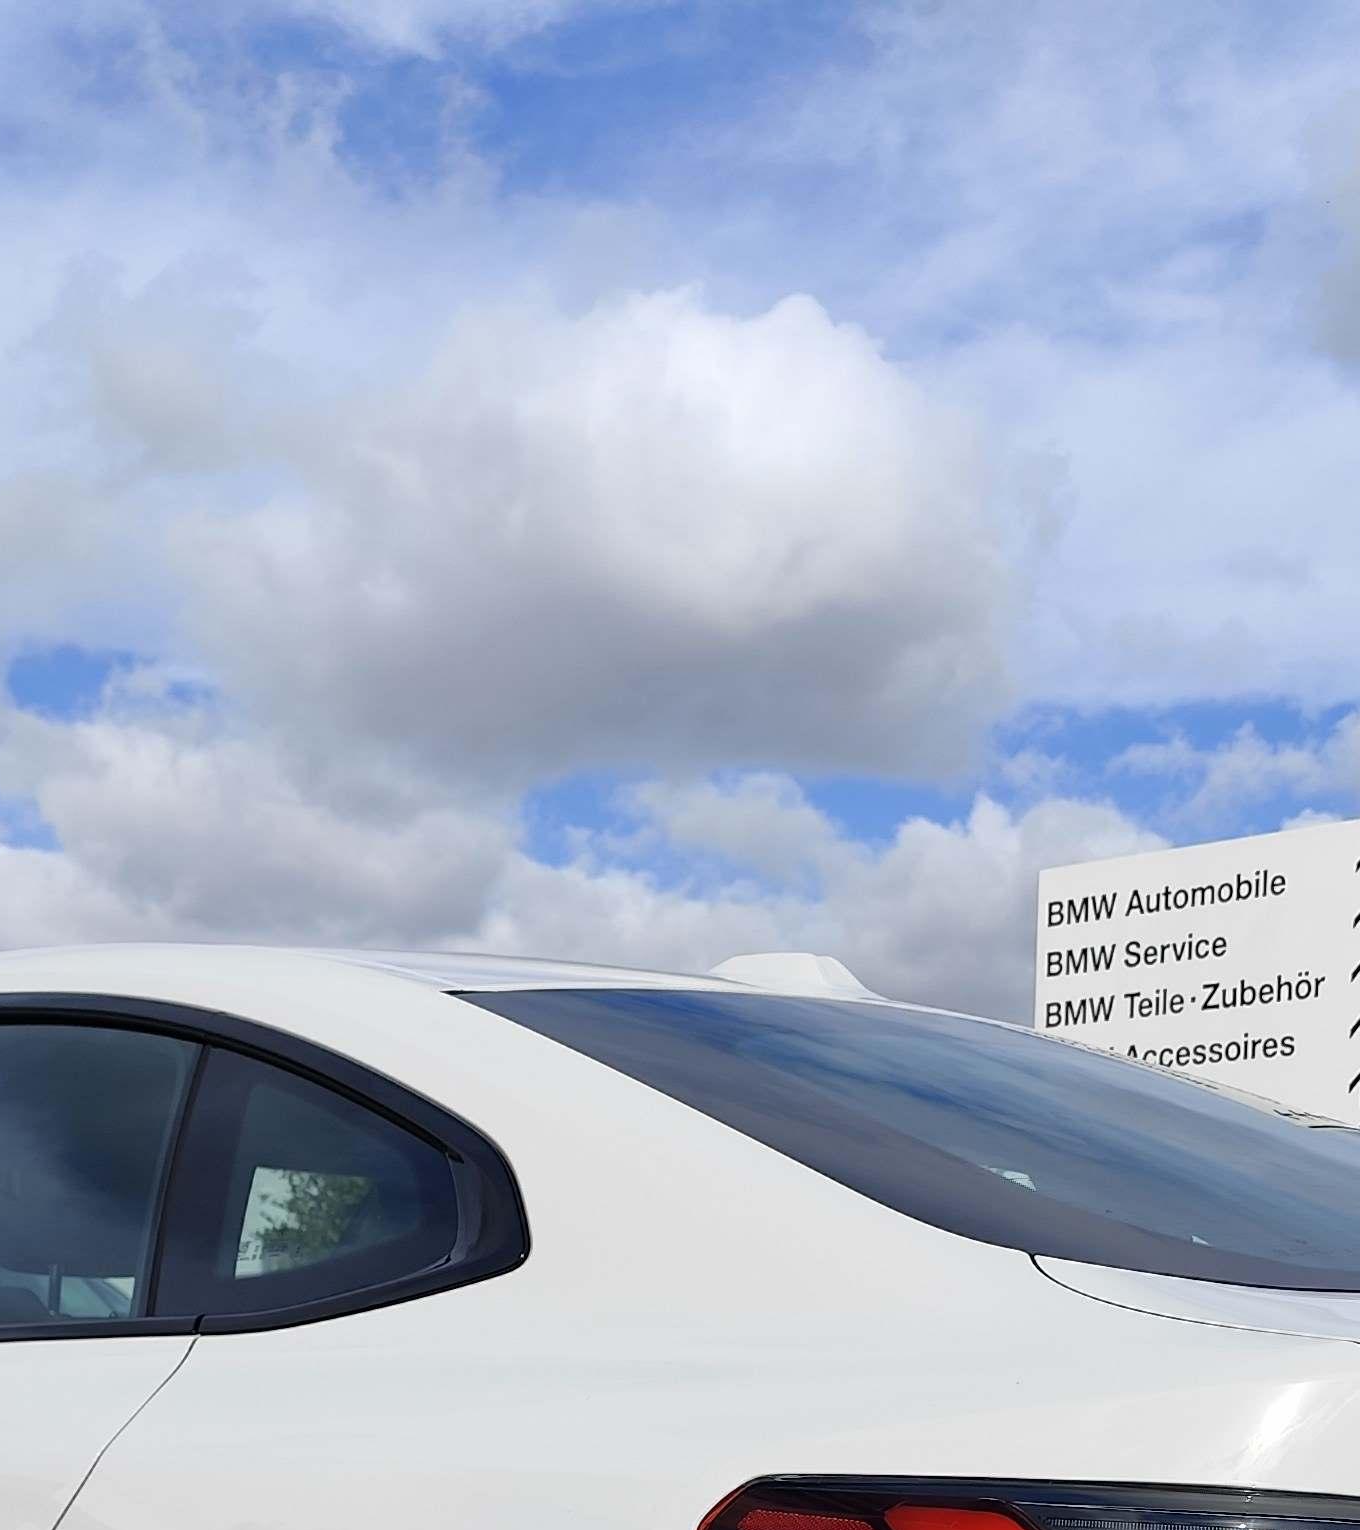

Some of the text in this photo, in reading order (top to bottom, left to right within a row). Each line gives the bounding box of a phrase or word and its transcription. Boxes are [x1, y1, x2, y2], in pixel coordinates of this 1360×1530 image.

[1047, 869, 1286, 928] BMW Automobile
[1046, 932, 1227, 978] BMW Service
[1045, 994, 1116, 1029] BMW
